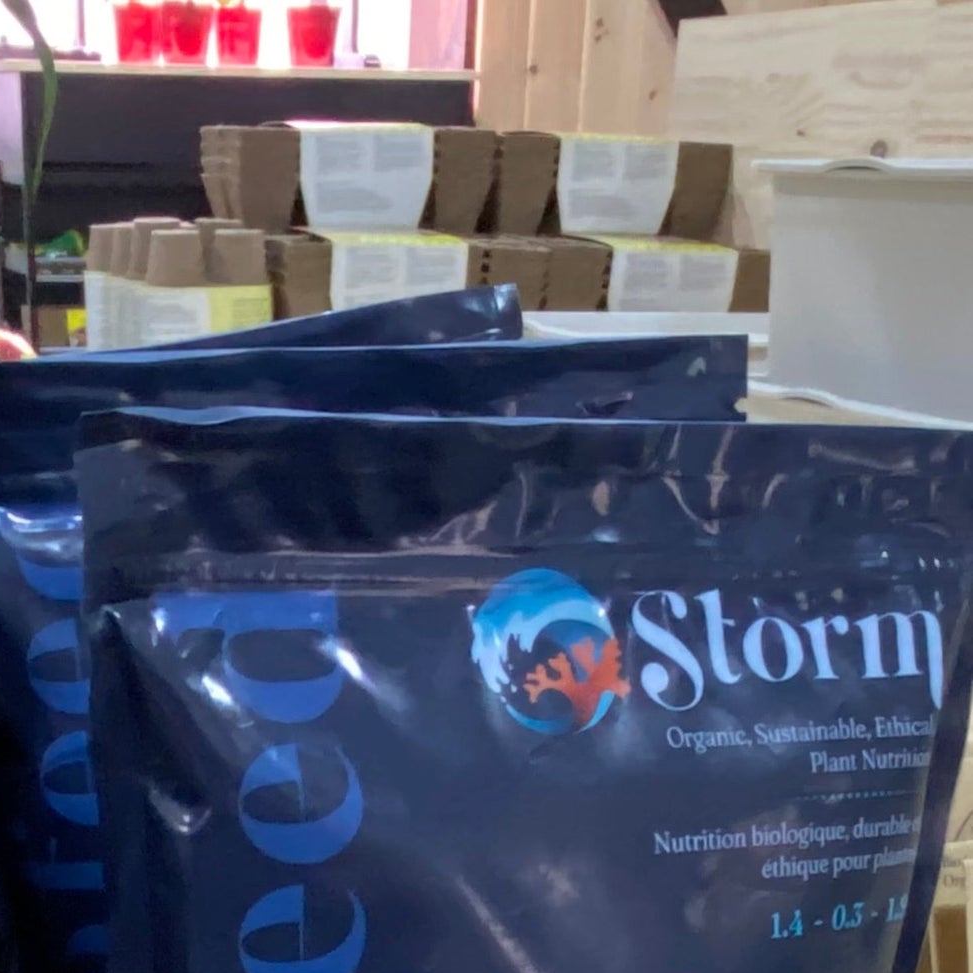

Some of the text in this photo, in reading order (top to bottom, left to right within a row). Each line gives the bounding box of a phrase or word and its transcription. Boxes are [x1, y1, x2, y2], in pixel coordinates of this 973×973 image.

[631, 588, 944, 712] Storm
[666, 725, 753, 754] Organic,
[755, 717, 872, 746] Sustainable,
[810, 749, 858, 773] Plant
[653, 828, 747, 856] Nutrition
[751, 819, 850, 850] biologique,
[853, 813, 911, 840] durable
[762, 855, 829, 882] éthique
[833, 854, 872, 878] pour
[770, 909, 804, 939] 1.4
[831, 902, 865, 932] 0.3
